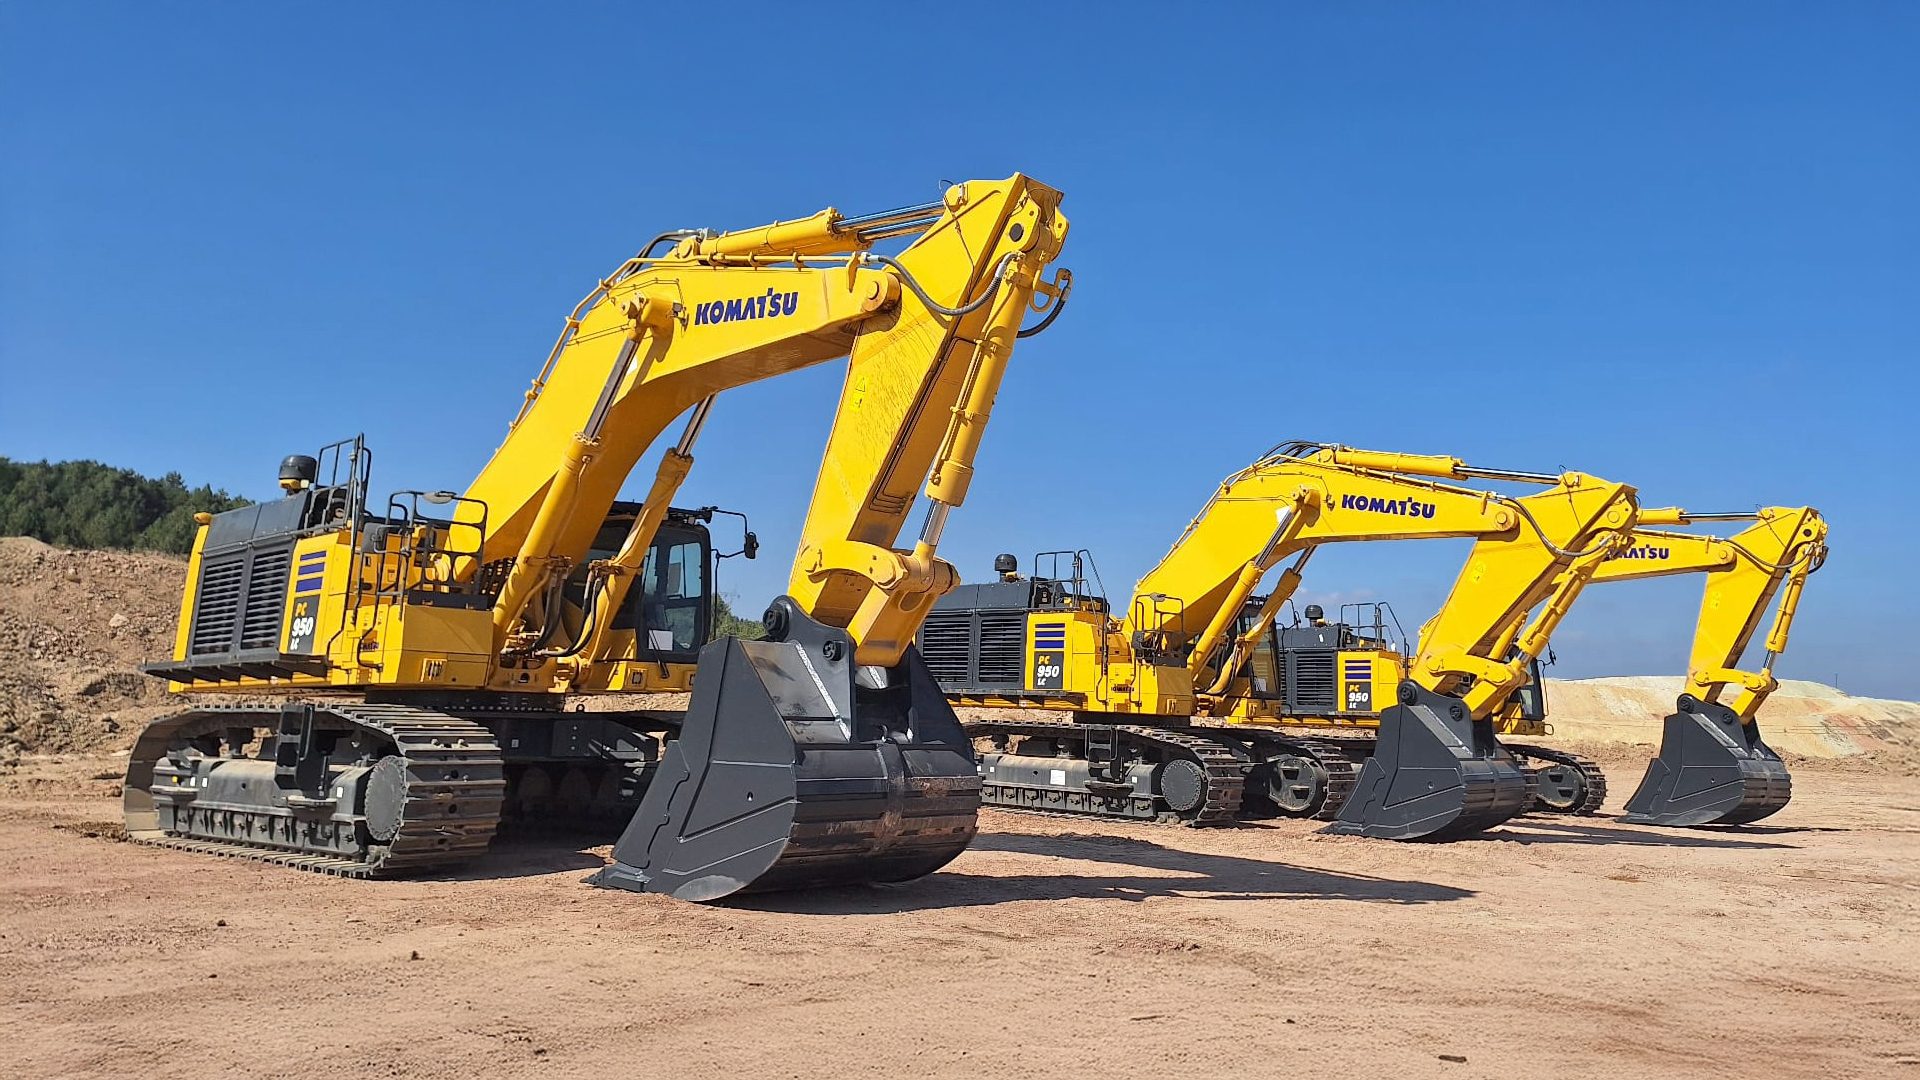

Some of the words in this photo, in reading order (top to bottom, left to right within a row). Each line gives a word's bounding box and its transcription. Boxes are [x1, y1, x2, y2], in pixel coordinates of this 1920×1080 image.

[694, 287, 799, 325] KOMATSU
[1341, 494, 1436, 518] KOMATSU
[295, 602, 308, 617] PC
[291, 616, 314, 637] 950
[1038, 655, 1051, 665] PC
[1037, 665, 1060, 678] 950
[1348, 692, 1369, 702] 950
